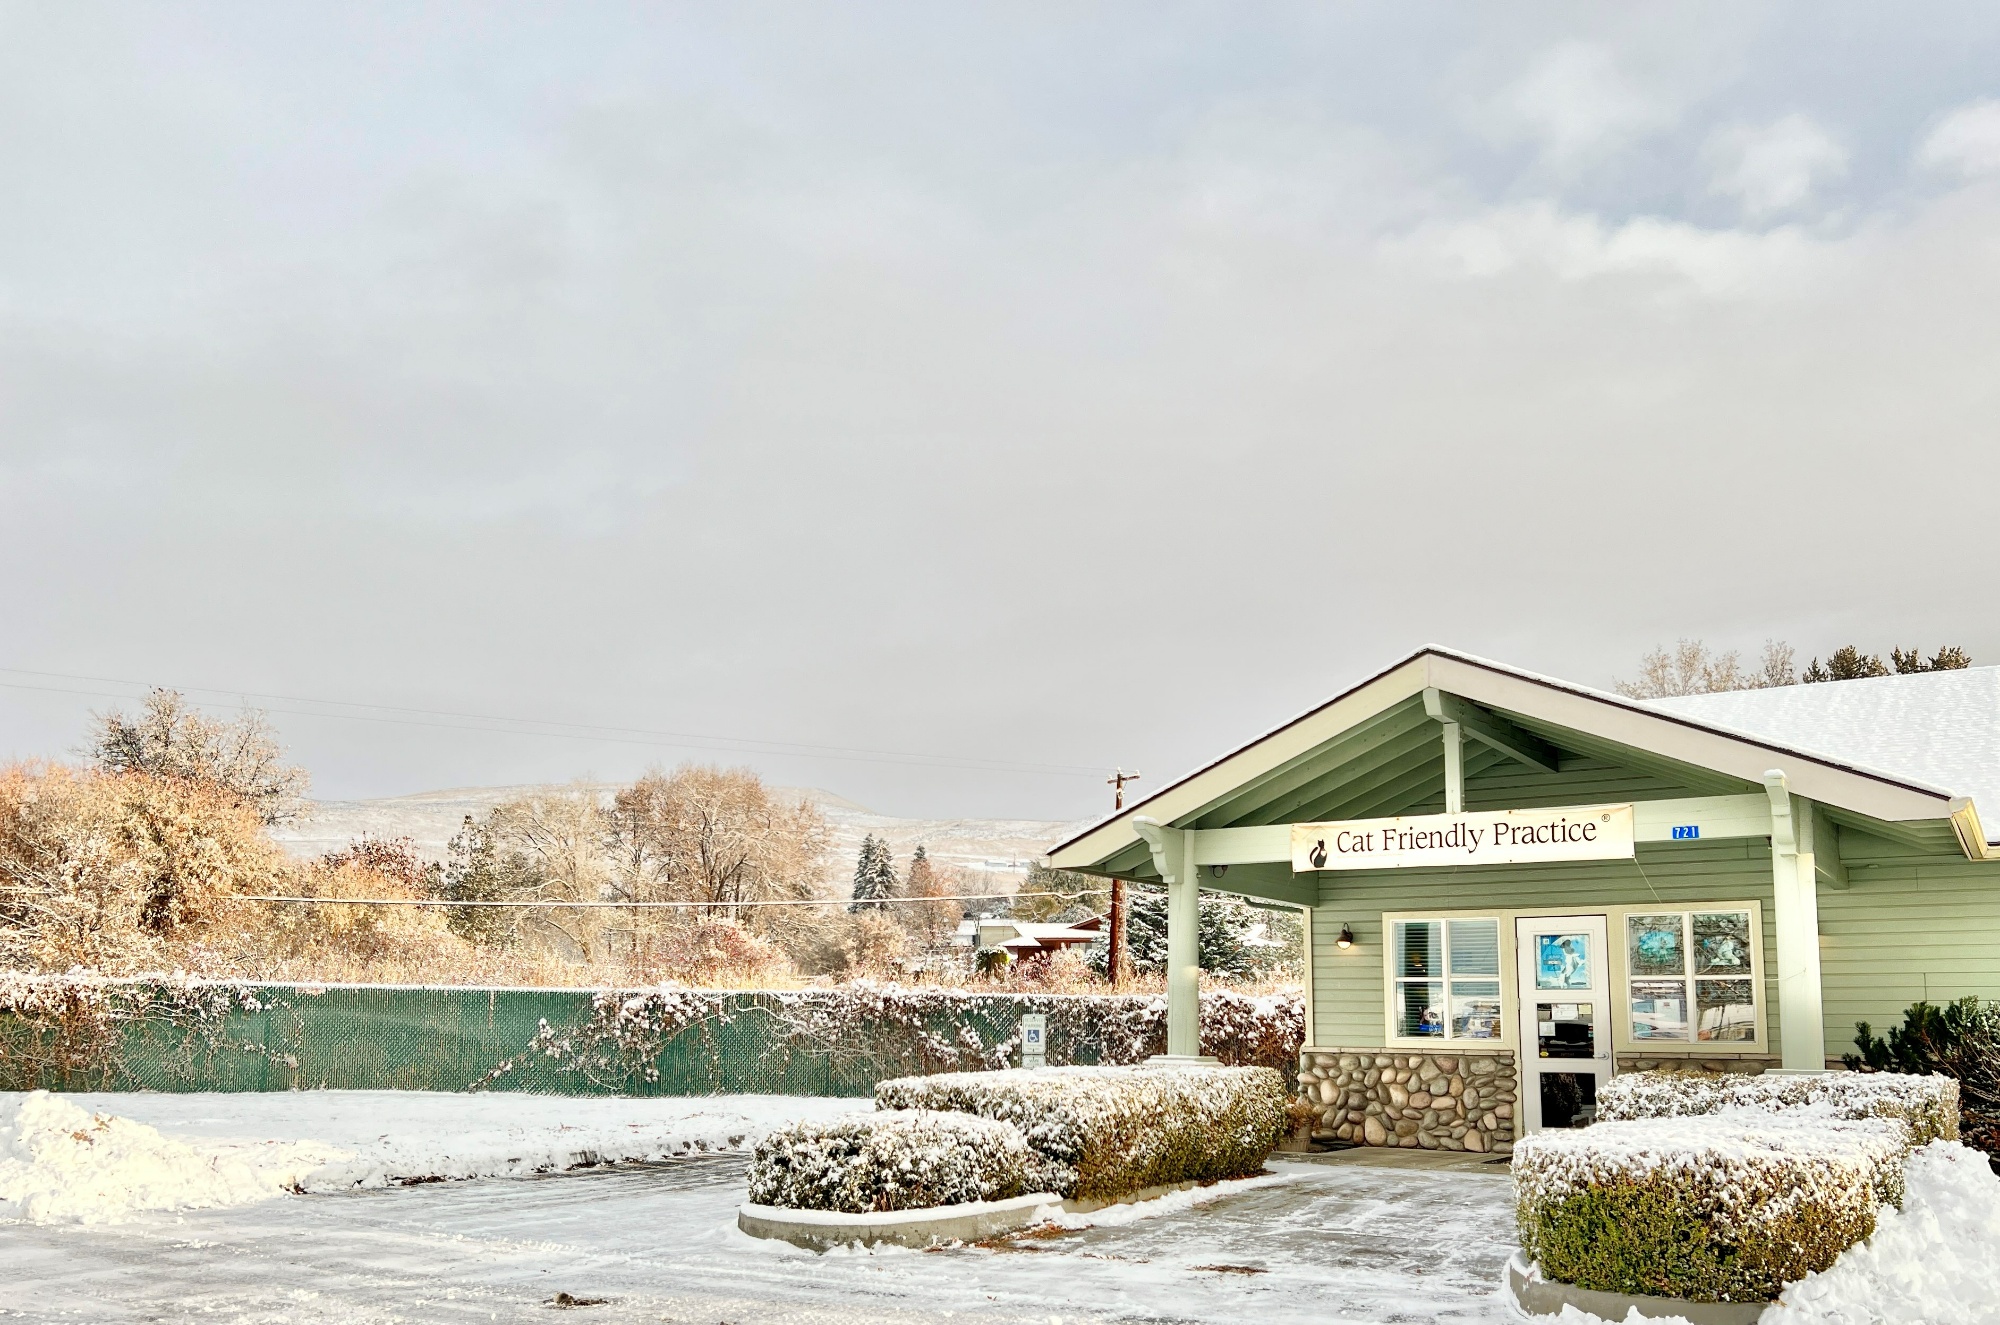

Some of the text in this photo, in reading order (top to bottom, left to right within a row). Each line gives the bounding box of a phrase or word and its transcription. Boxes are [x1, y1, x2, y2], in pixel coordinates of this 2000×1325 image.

[1337, 817, 1597, 854] Cat Friendly Practice
[1674, 826, 1696, 839] 721
